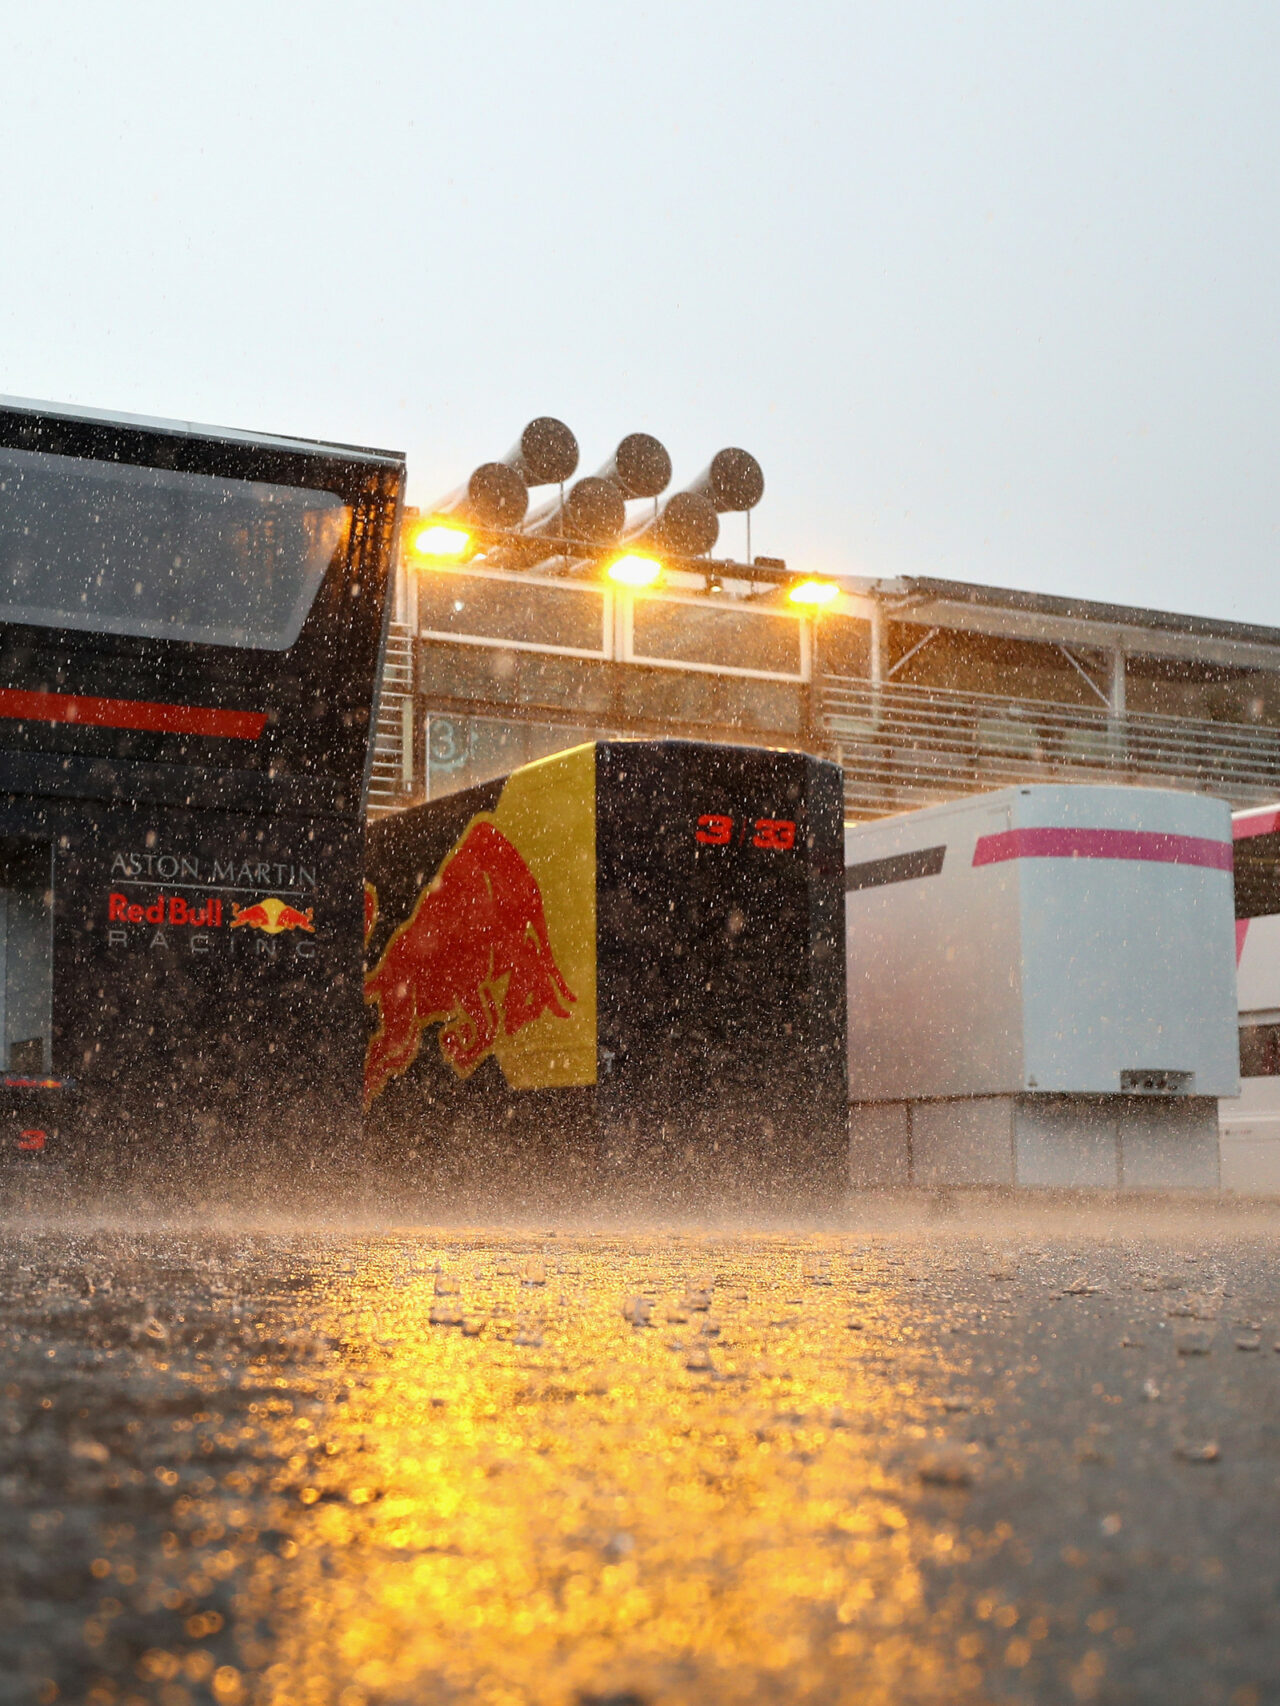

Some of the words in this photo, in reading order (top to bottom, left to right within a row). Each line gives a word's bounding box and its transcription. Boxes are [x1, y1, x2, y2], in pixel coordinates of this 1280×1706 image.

[696, 814, 733, 845] 3
[753, 819, 796, 850] 33
[111, 853, 199, 879] ASTON
[212, 861, 317, 886] MARTIN
[108, 893, 165, 924] Red
[169, 896, 222, 927] Bull
[108, 930, 316, 958] RACING
[18, 1130, 46, 1150] 3
